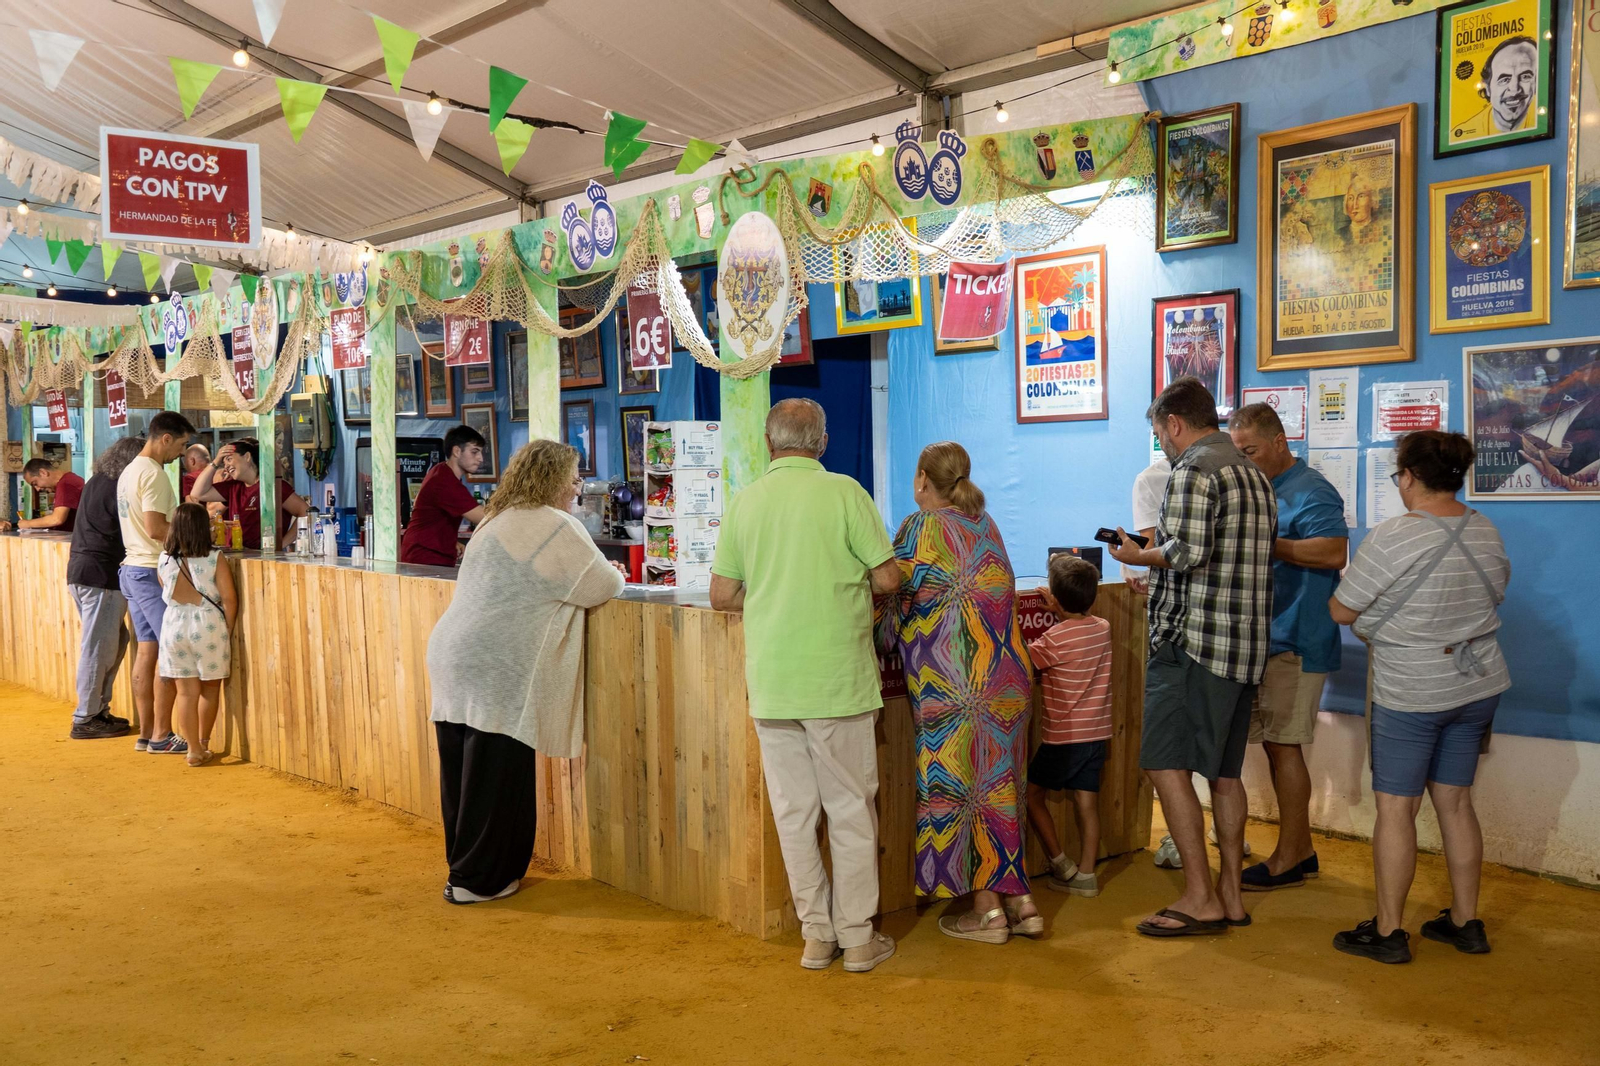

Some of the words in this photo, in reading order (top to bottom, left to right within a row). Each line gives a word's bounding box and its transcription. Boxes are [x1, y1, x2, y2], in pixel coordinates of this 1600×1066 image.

[1457, 12, 1492, 32] FIESTAS
[1456, 17, 1525, 47] COLOMBINAS
[1456, 46, 1472, 54] HUELVA
[1473, 42, 1485, 51] 2015
[1170, 129, 1191, 140] FIESTAS
[1192, 121, 1229, 136] COLOMBINAS
[139, 147, 220, 175] PAGOS
[126, 176, 179, 199] CON
[184, 181, 228, 203] TPV
[119, 210, 179, 224] HERMANDAD
[181, 215, 193, 225] DE
[194, 217, 205, 226] LA
[207, 218, 217, 227] FE
[1467, 269, 1509, 283] FIESTAS
[1451, 278, 1525, 298] COLOMBINAS
[1282, 299, 1320, 316] FIESTAS
[1323, 291, 1388, 312] COLOMBINAS
[1461, 302, 1494, 311] HUELVA
[1495, 299, 1514, 308] 2016
[353, 310, 361, 323] DE
[450, 318, 479, 333] PONCHE
[635, 315, 666, 357] 6€
[1283, 326, 1305, 336] HUELVA
[1312, 324, 1324, 333] DEL
[1326, 324, 1329, 332] 1
[1331, 322, 1339, 332] AL
[1341, 321, 1346, 331] 6
[1348, 321, 1357, 330] DE
[1359, 318, 1386, 329] AGOSTO
[346, 347, 363, 363] 10€
[468, 336, 483, 356] 2€
[236, 370, 254, 393] 1,5€
[1026, 378, 1096, 398] COLOMB
[109, 399, 127, 420] 2,5€
[1485, 425, 1491, 435] 29
[1492, 425, 1498, 434] de
[1499, 425, 1511, 434] Julio
[1477, 440, 1482, 448] al
[1482, 440, 1487, 448] 4
[1487, 440, 1493, 448] de
[1494, 440, 1511, 450] Agosto
[400, 458, 426, 466] Minute
[1477, 451, 1519, 467] HUELVA
[1476, 474, 1532, 488] FIESTAS
